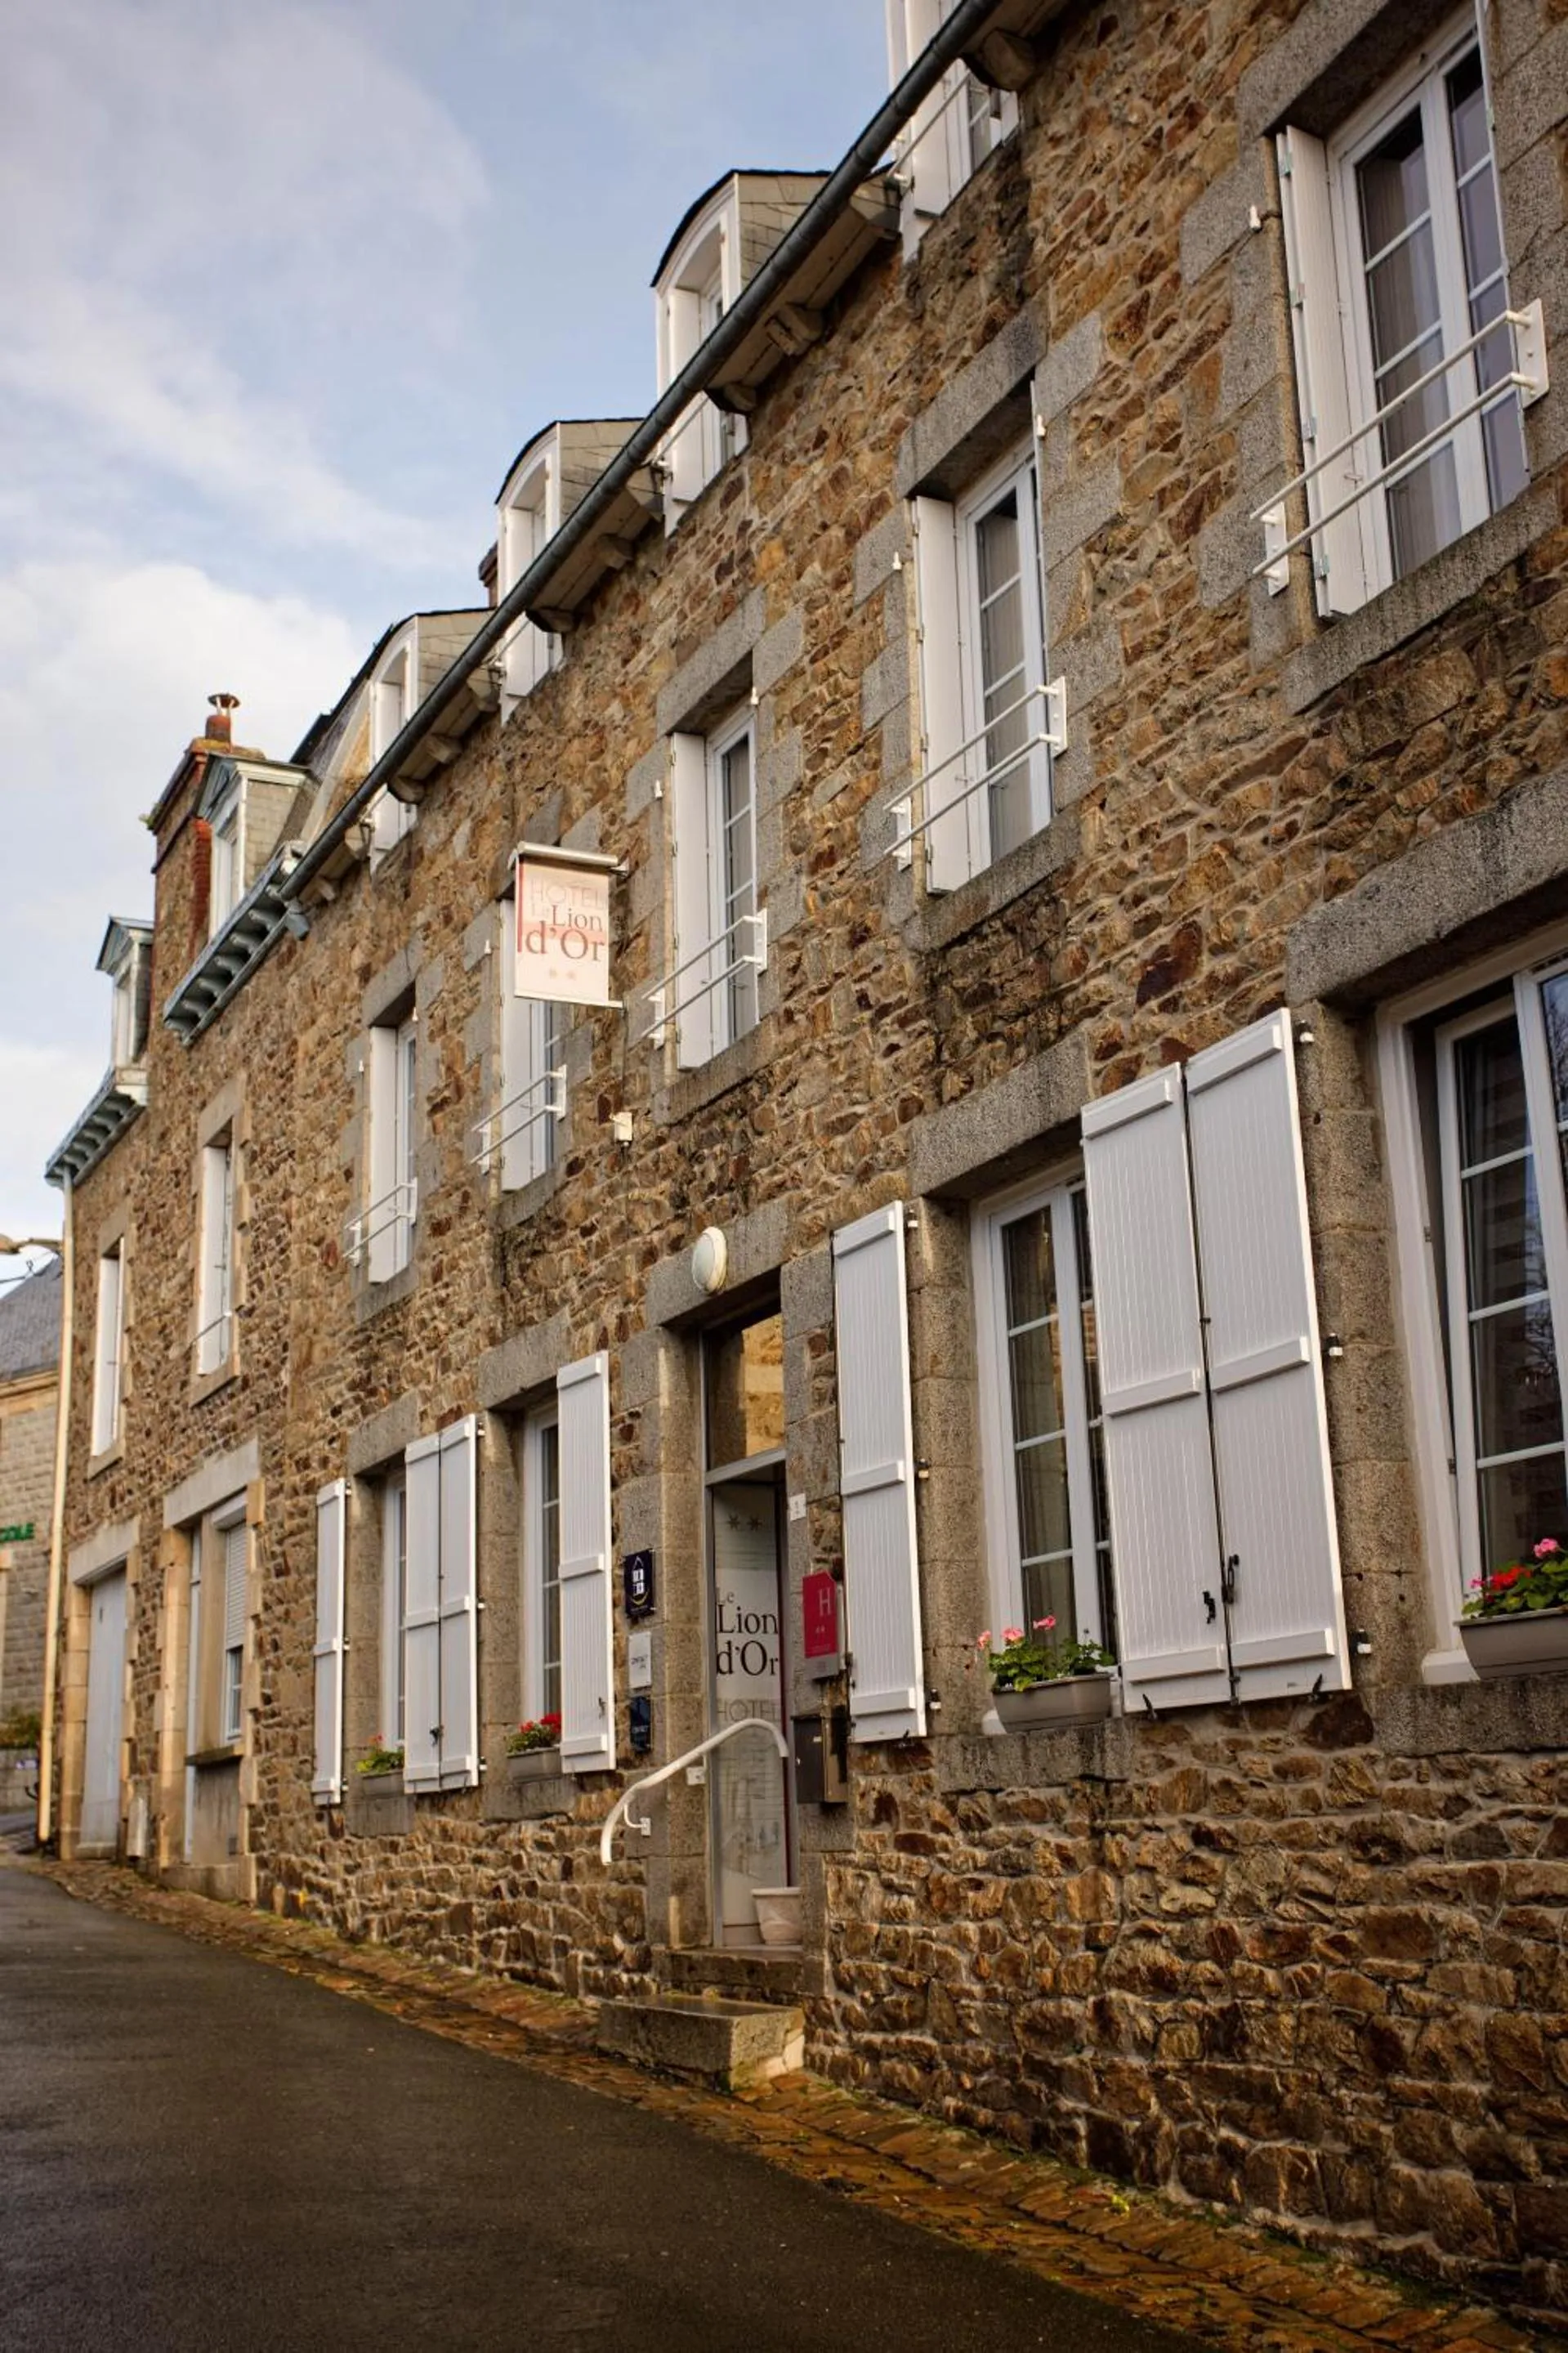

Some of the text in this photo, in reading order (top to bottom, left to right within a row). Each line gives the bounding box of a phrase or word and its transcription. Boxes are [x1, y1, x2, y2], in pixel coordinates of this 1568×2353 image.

[551, 904, 603, 933] Lion
[525, 919, 605, 961] d'Or
[716, 1586, 735, 1604] Le
[818, 1587, 832, 1617] H
[717, 1604, 779, 1635] Lion
[716, 1639, 779, 1676] d'Or
